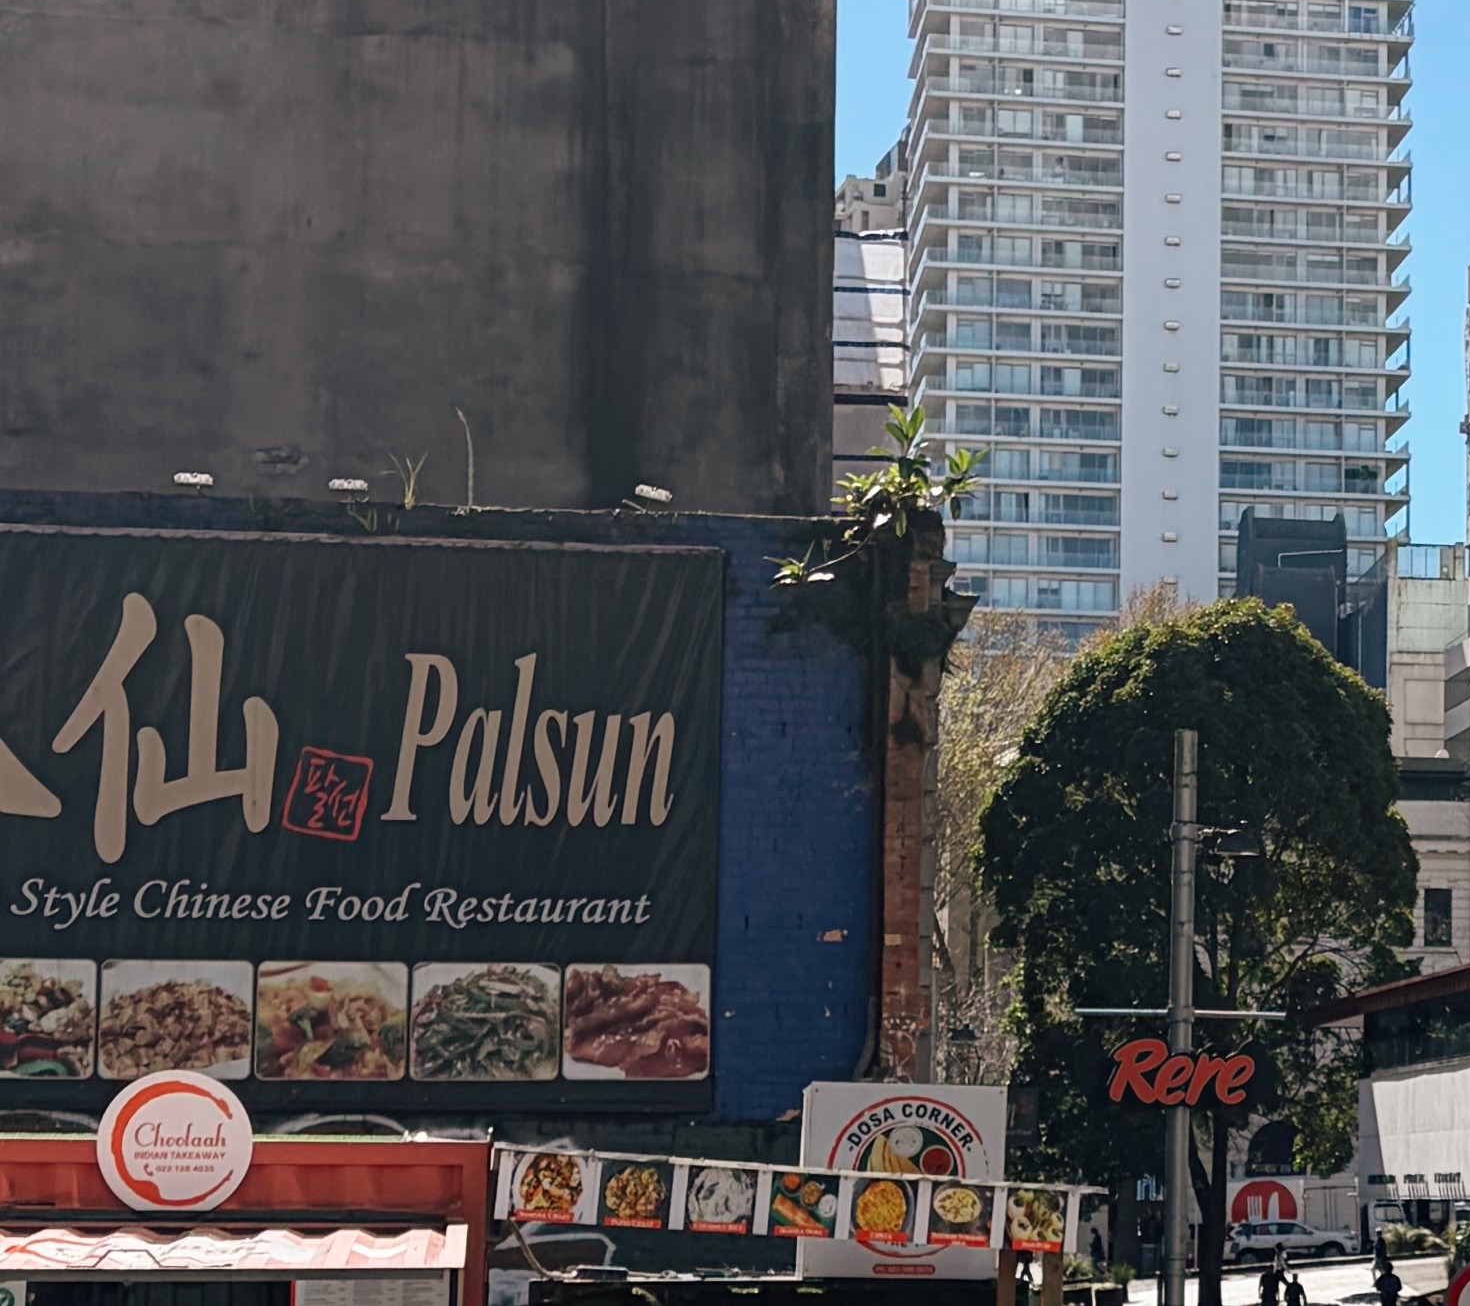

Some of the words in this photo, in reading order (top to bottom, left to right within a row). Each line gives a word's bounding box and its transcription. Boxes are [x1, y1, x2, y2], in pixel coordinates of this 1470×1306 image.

[0, 593, 279, 863] 仙
[381, 652, 675, 828] Palsun
[10, 877, 120, 930] Style
[133, 879, 291, 920] Chinese
[305, 882, 420, 922] Food
[424, 886, 652, 930] Restaurant
[1109, 1038, 1255, 1105] Rere
[133, 1151, 168, 1160] INDIAN
[170, 1151, 226, 1160] TAKEAWAY
[134, 1122, 227, 1148] Choolaah
